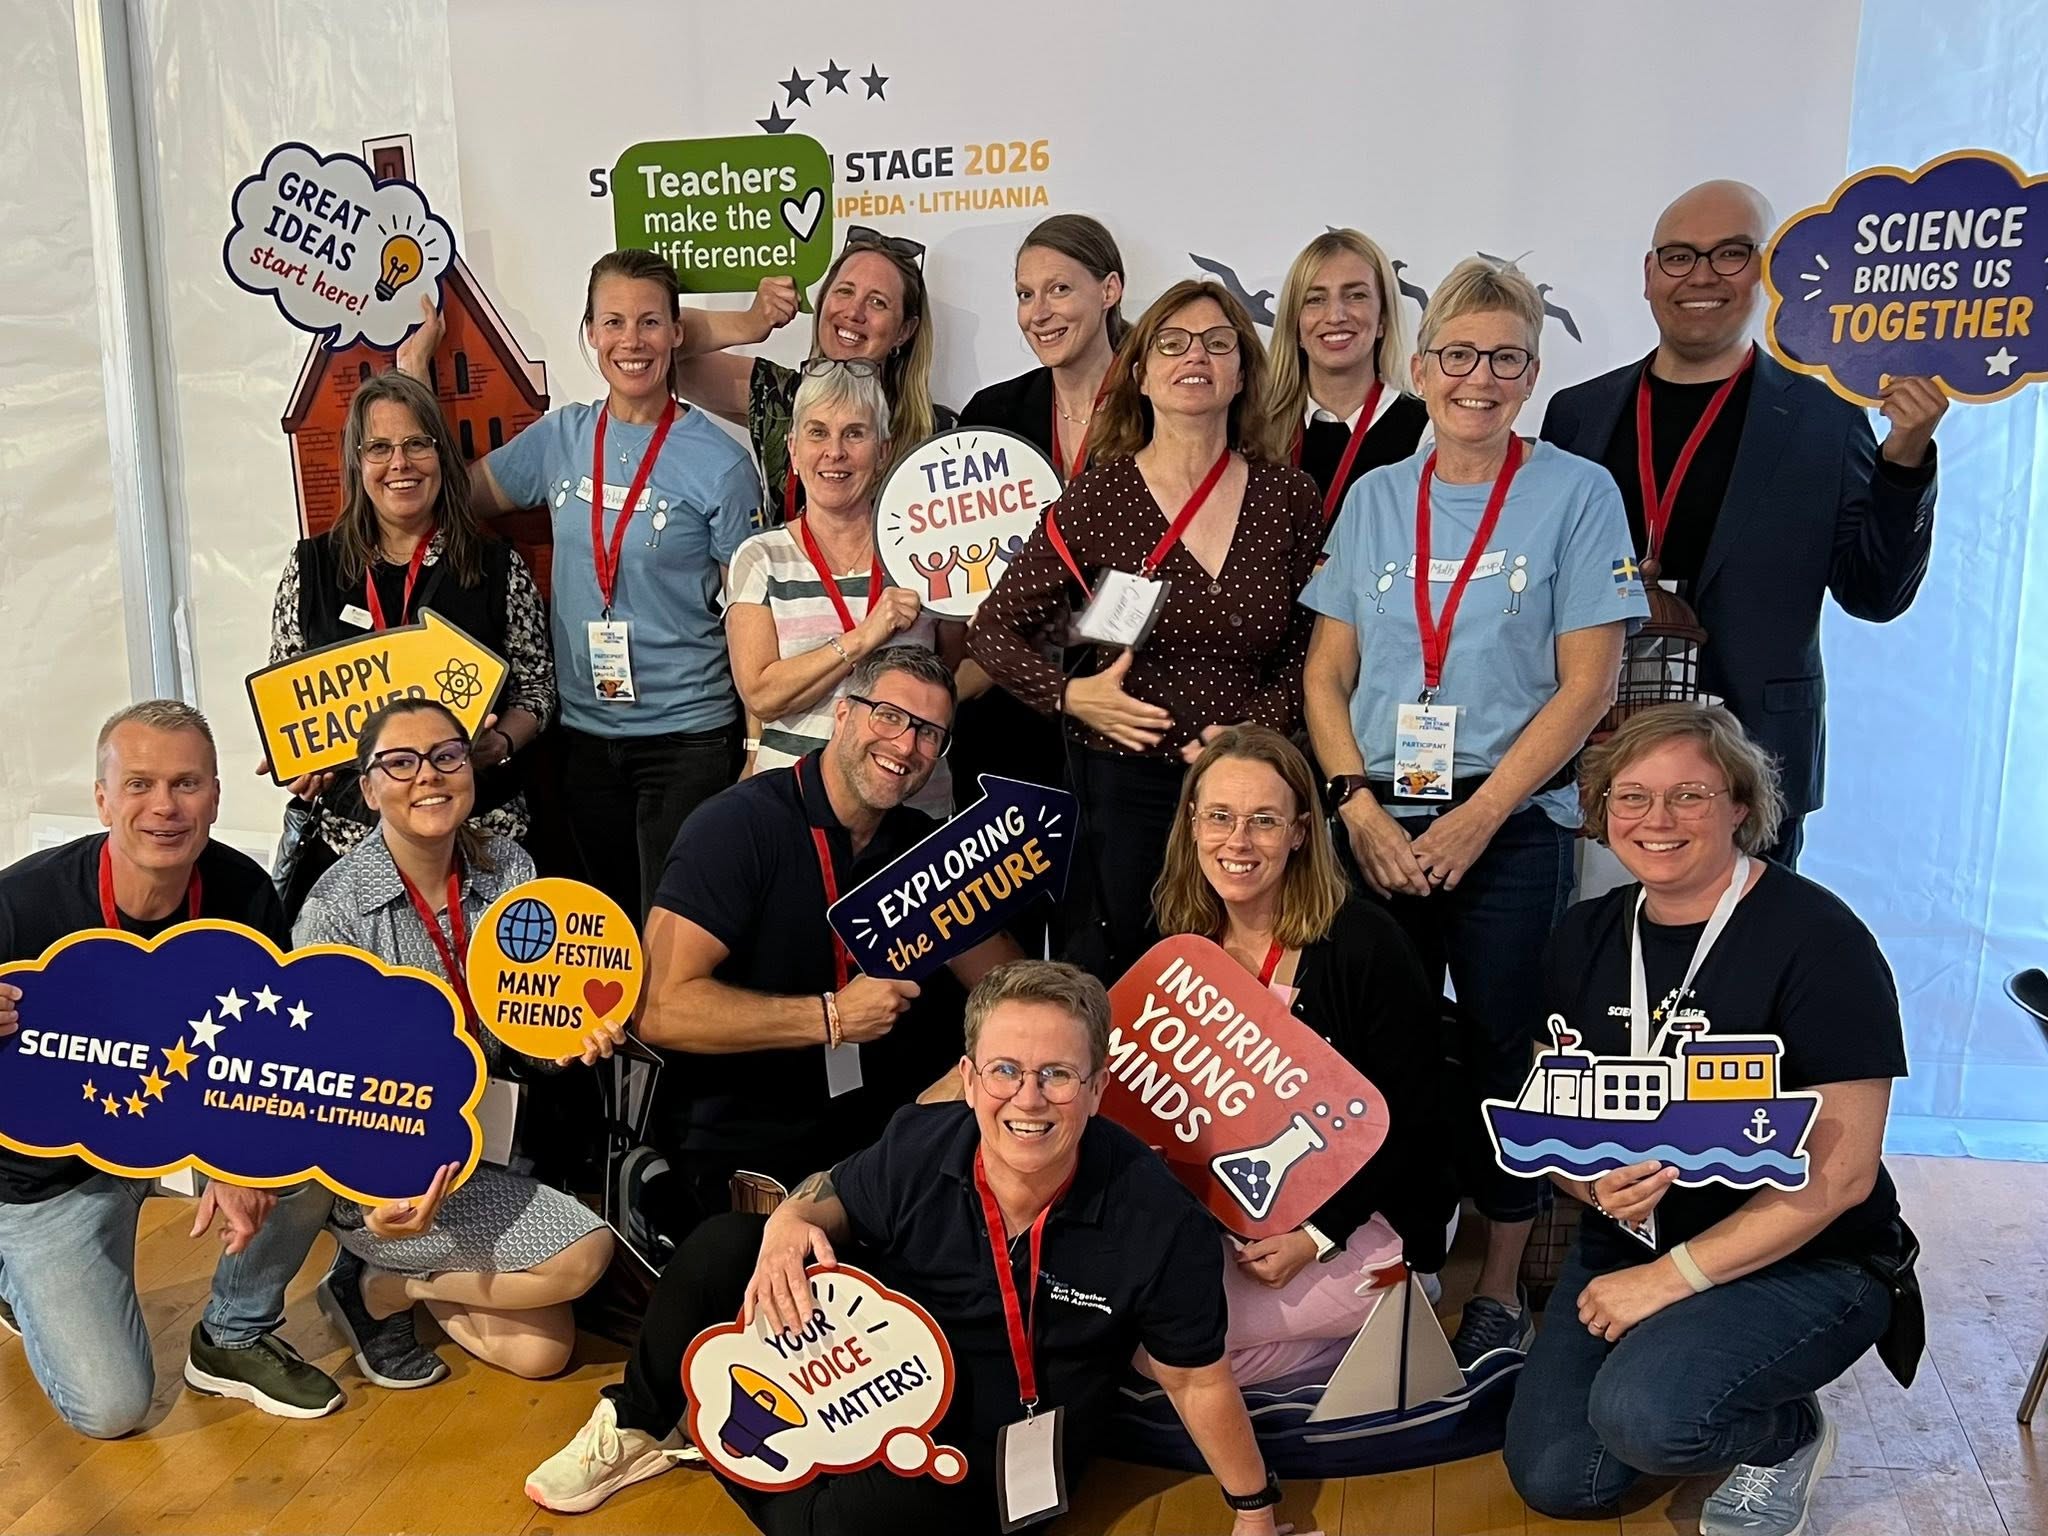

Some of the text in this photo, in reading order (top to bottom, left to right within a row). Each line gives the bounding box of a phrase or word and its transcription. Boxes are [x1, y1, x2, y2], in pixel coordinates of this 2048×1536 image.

[637, 161, 798, 199] Teachers
[845, 146, 954, 183] STAGE
[963, 139, 1050, 176] 2026
[278, 171, 371, 235] GREAT
[644, 202, 772, 234] make the
[919, 185, 1049, 214] LITHUANIA
[263, 205, 356, 271] IDEAS
[1853, 206, 2028, 255] SCIENCE
[249, 246, 370, 316] start here!
[1853, 258, 2013, 294] BRINGS US
[1828, 296, 2034, 345] TOGETHER
[920, 447, 1010, 493] TEAM
[907, 479, 1038, 534] SCIENCE
[292, 650, 391, 711] HAPPY
[1402, 740, 1447, 749] PARTICIPANT
[877, 805, 1026, 929] EXPLORING
[565, 912, 606, 938] ONE
[886, 837, 1052, 972] the FUTURE
[555, 942, 633, 971] FESTIVAL
[497, 970, 562, 998] MANY
[497, 1000, 583, 1029] FRIENDS
[1155, 956, 1309, 1100] INSPIRING
[18, 1028, 434, 1111] SCIENCE ON STAGE 2026
[1132, 992, 1256, 1117] YOUNG
[1108, 1026, 1213, 1143] MINDS
[203, 1088, 427, 1137] KLAIPĖDA LITHUANIA
[1050, 1292, 1070, 1303] With
[1052, 1285, 1069, 1295] Run
[1070, 1288, 1107, 1302] Together
[764, 1308, 836, 1360] YOUR
[788, 1336, 872, 1396] VOICE
[816, 1354, 933, 1434] MATTERS!
